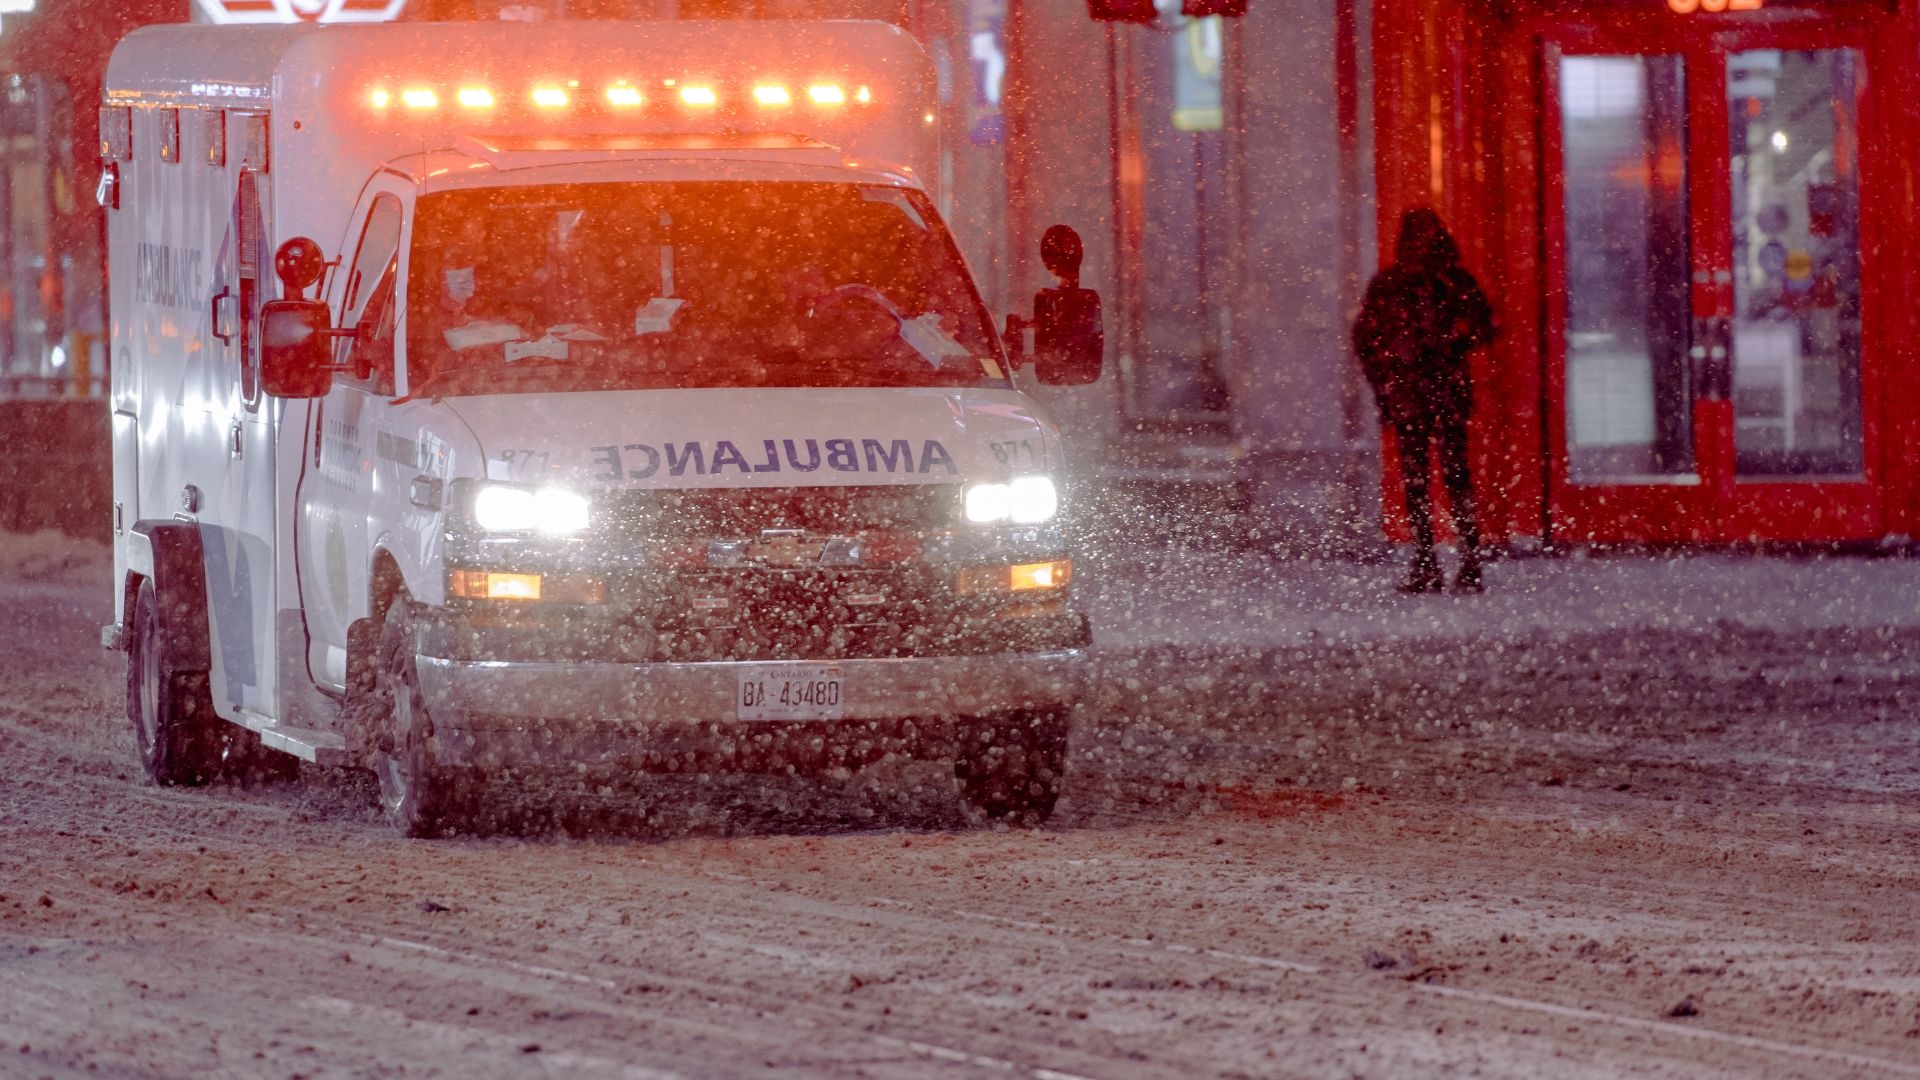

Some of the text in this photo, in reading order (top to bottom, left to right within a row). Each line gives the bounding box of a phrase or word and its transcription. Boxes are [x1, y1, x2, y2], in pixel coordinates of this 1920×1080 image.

[135, 242, 202, 312] AMBULANCE
[501, 449, 550, 474] 871
[989, 439, 1033, 465] 871
